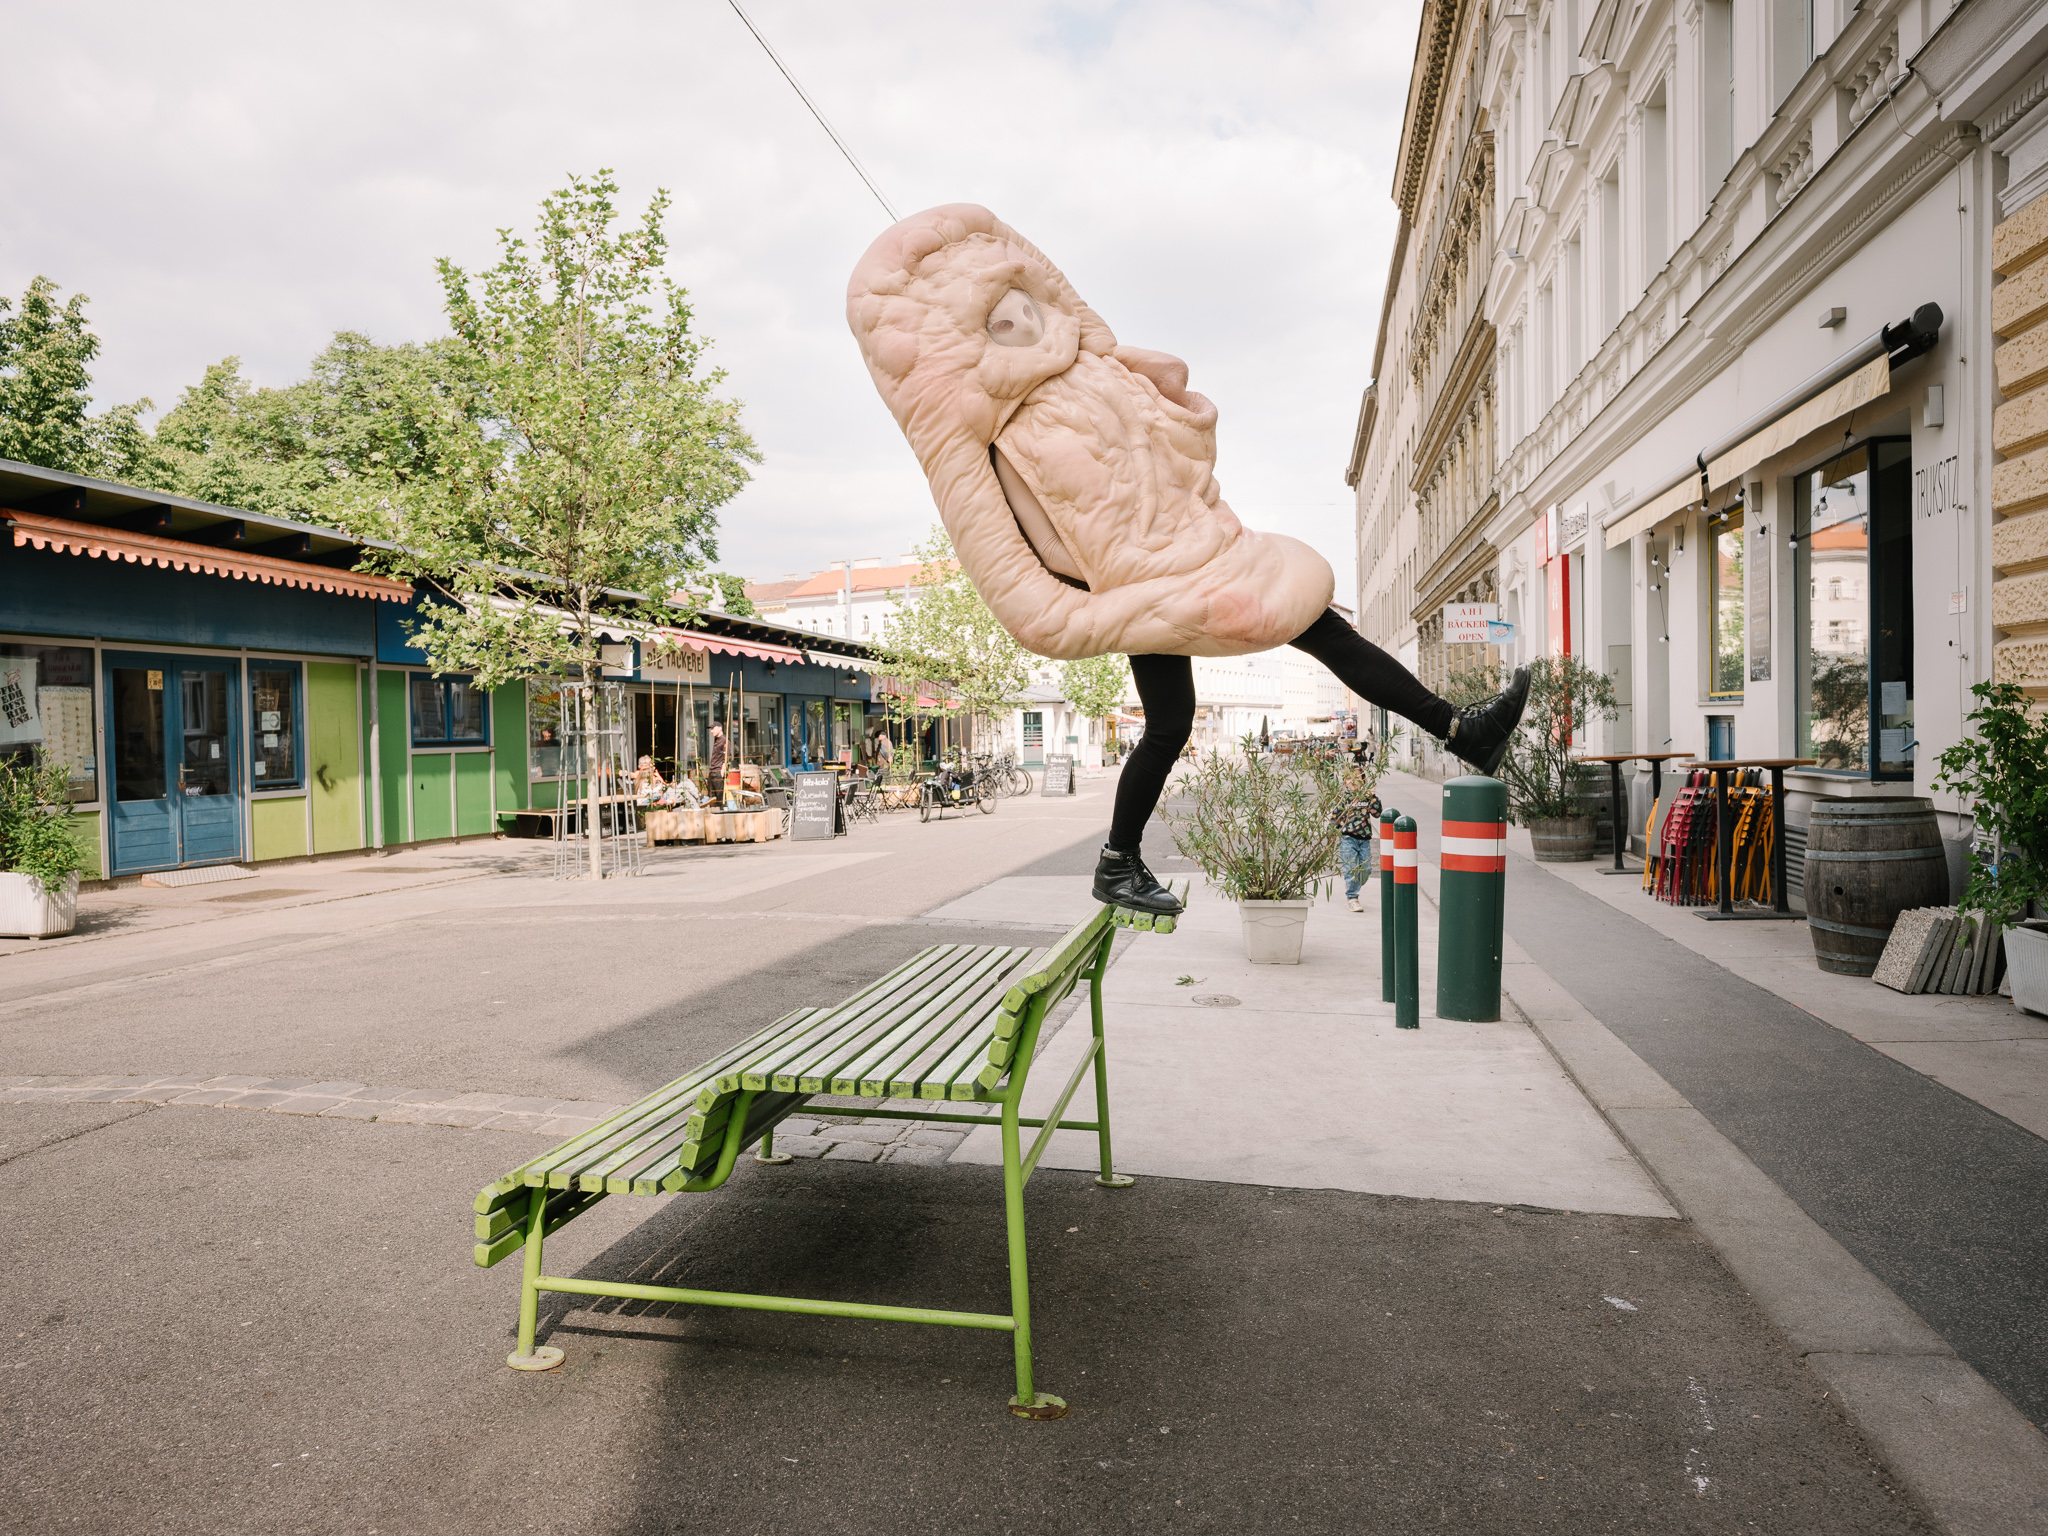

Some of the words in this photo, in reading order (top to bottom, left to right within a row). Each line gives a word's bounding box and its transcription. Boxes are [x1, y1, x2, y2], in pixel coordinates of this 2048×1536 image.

[1458, 633, 1484, 641] OPEN
[666, 650, 704, 673] TACKEREI
[1, 690, 23, 704] EDH
[2, 697, 26, 712] OFST
[803, 778, 829, 786] fritz-kola
